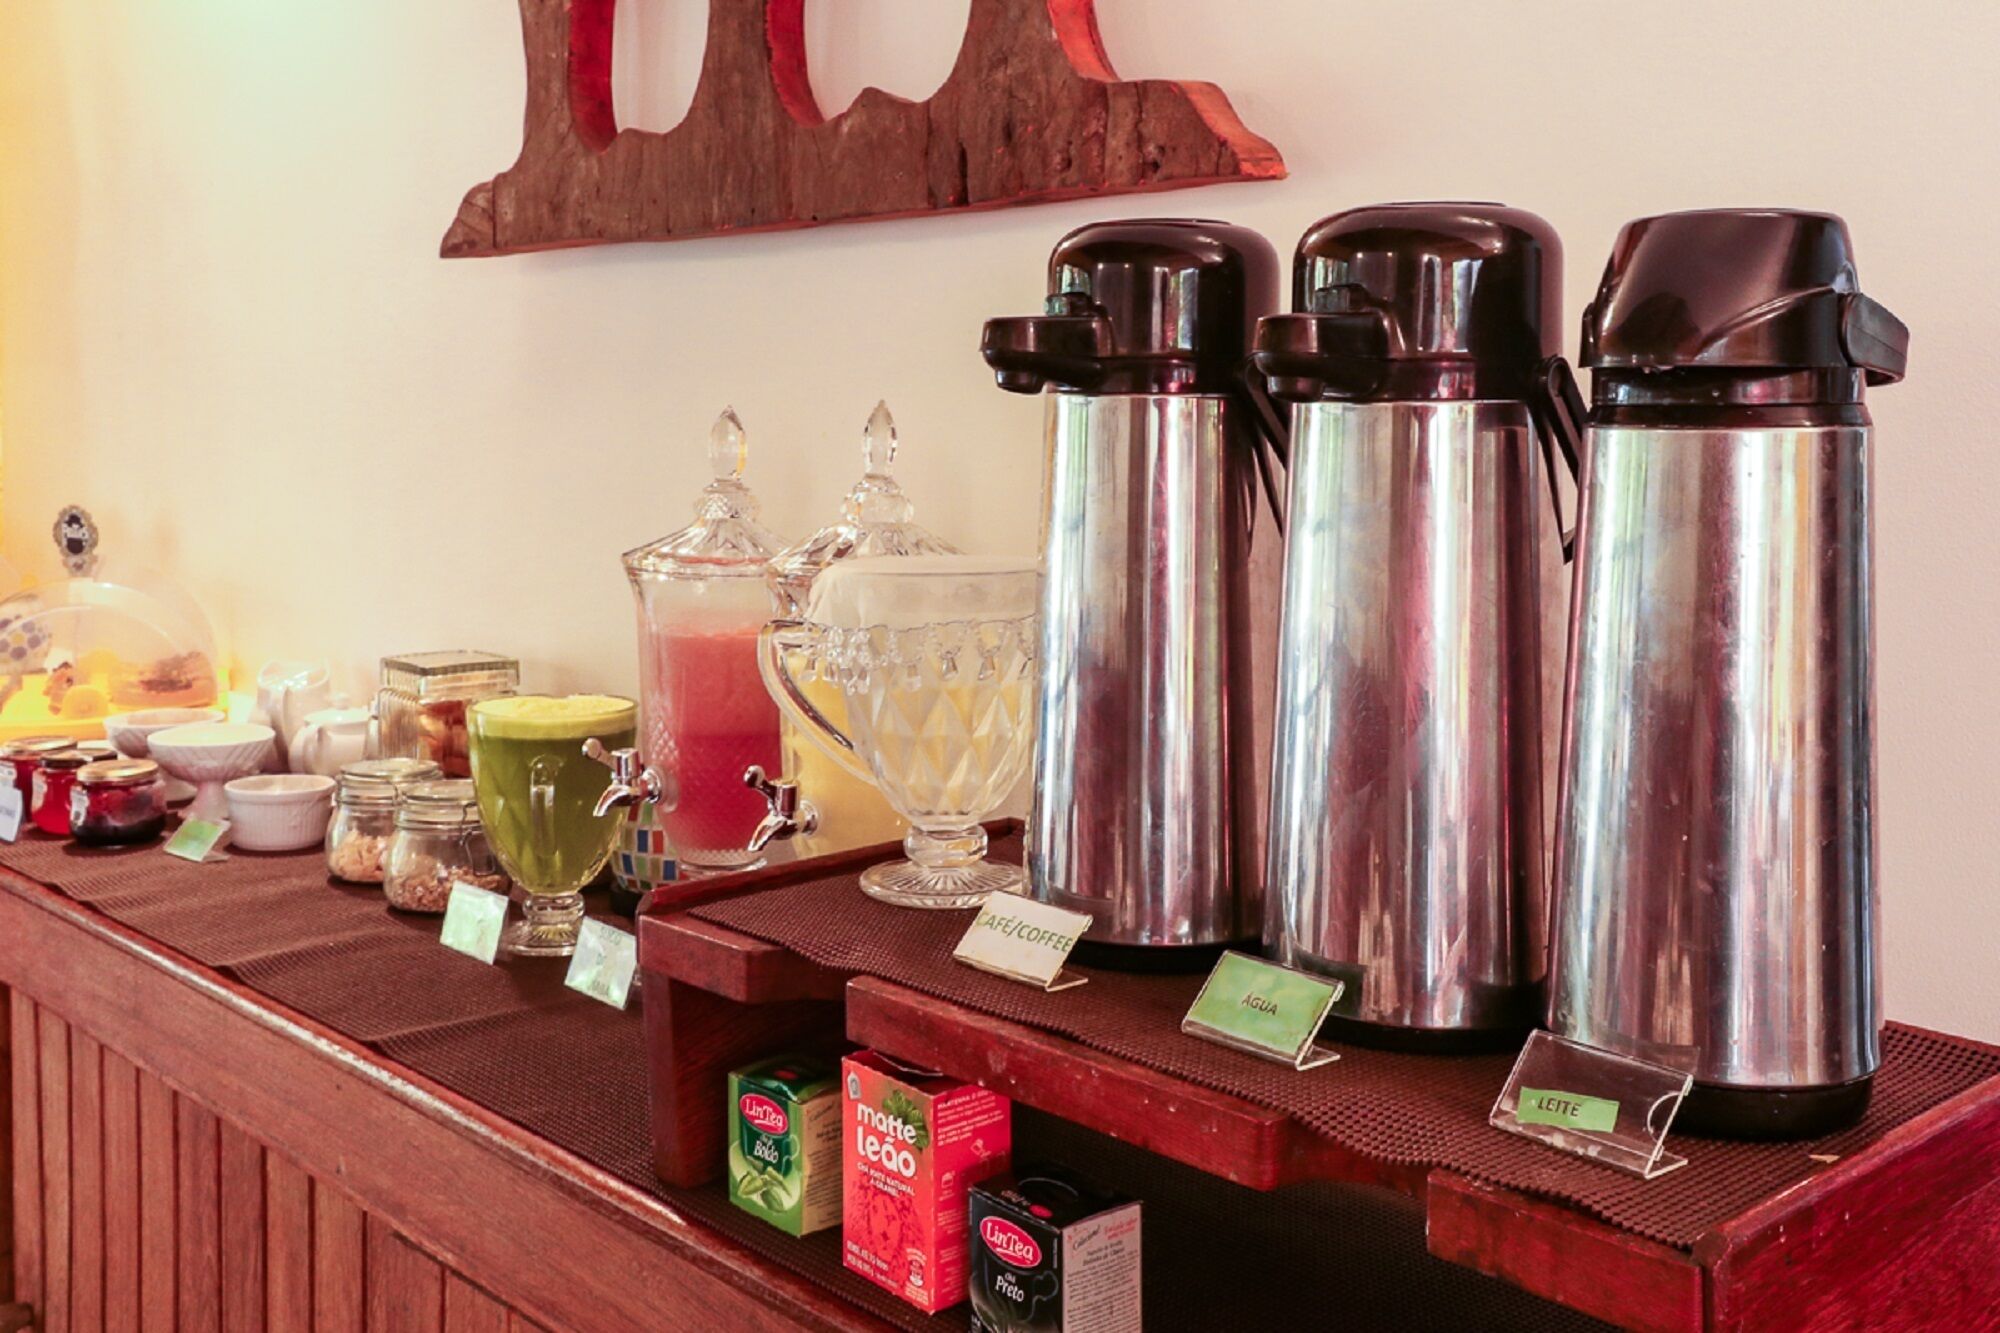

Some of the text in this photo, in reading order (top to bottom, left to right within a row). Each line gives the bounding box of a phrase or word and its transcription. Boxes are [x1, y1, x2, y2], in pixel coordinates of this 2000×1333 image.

[976, 911, 1074, 954] CAFÉ/COFFEE
[1241, 991, 1278, 1017] ÁGUA
[745, 1099, 784, 1130] LinTea
[857, 1103, 917, 1144] matte
[1537, 1096, 1583, 1118] LEITE
[857, 1126, 916, 1178] leão
[986, 1222, 1034, 1262] LinTea
[995, 1275, 1025, 1302] Preto
